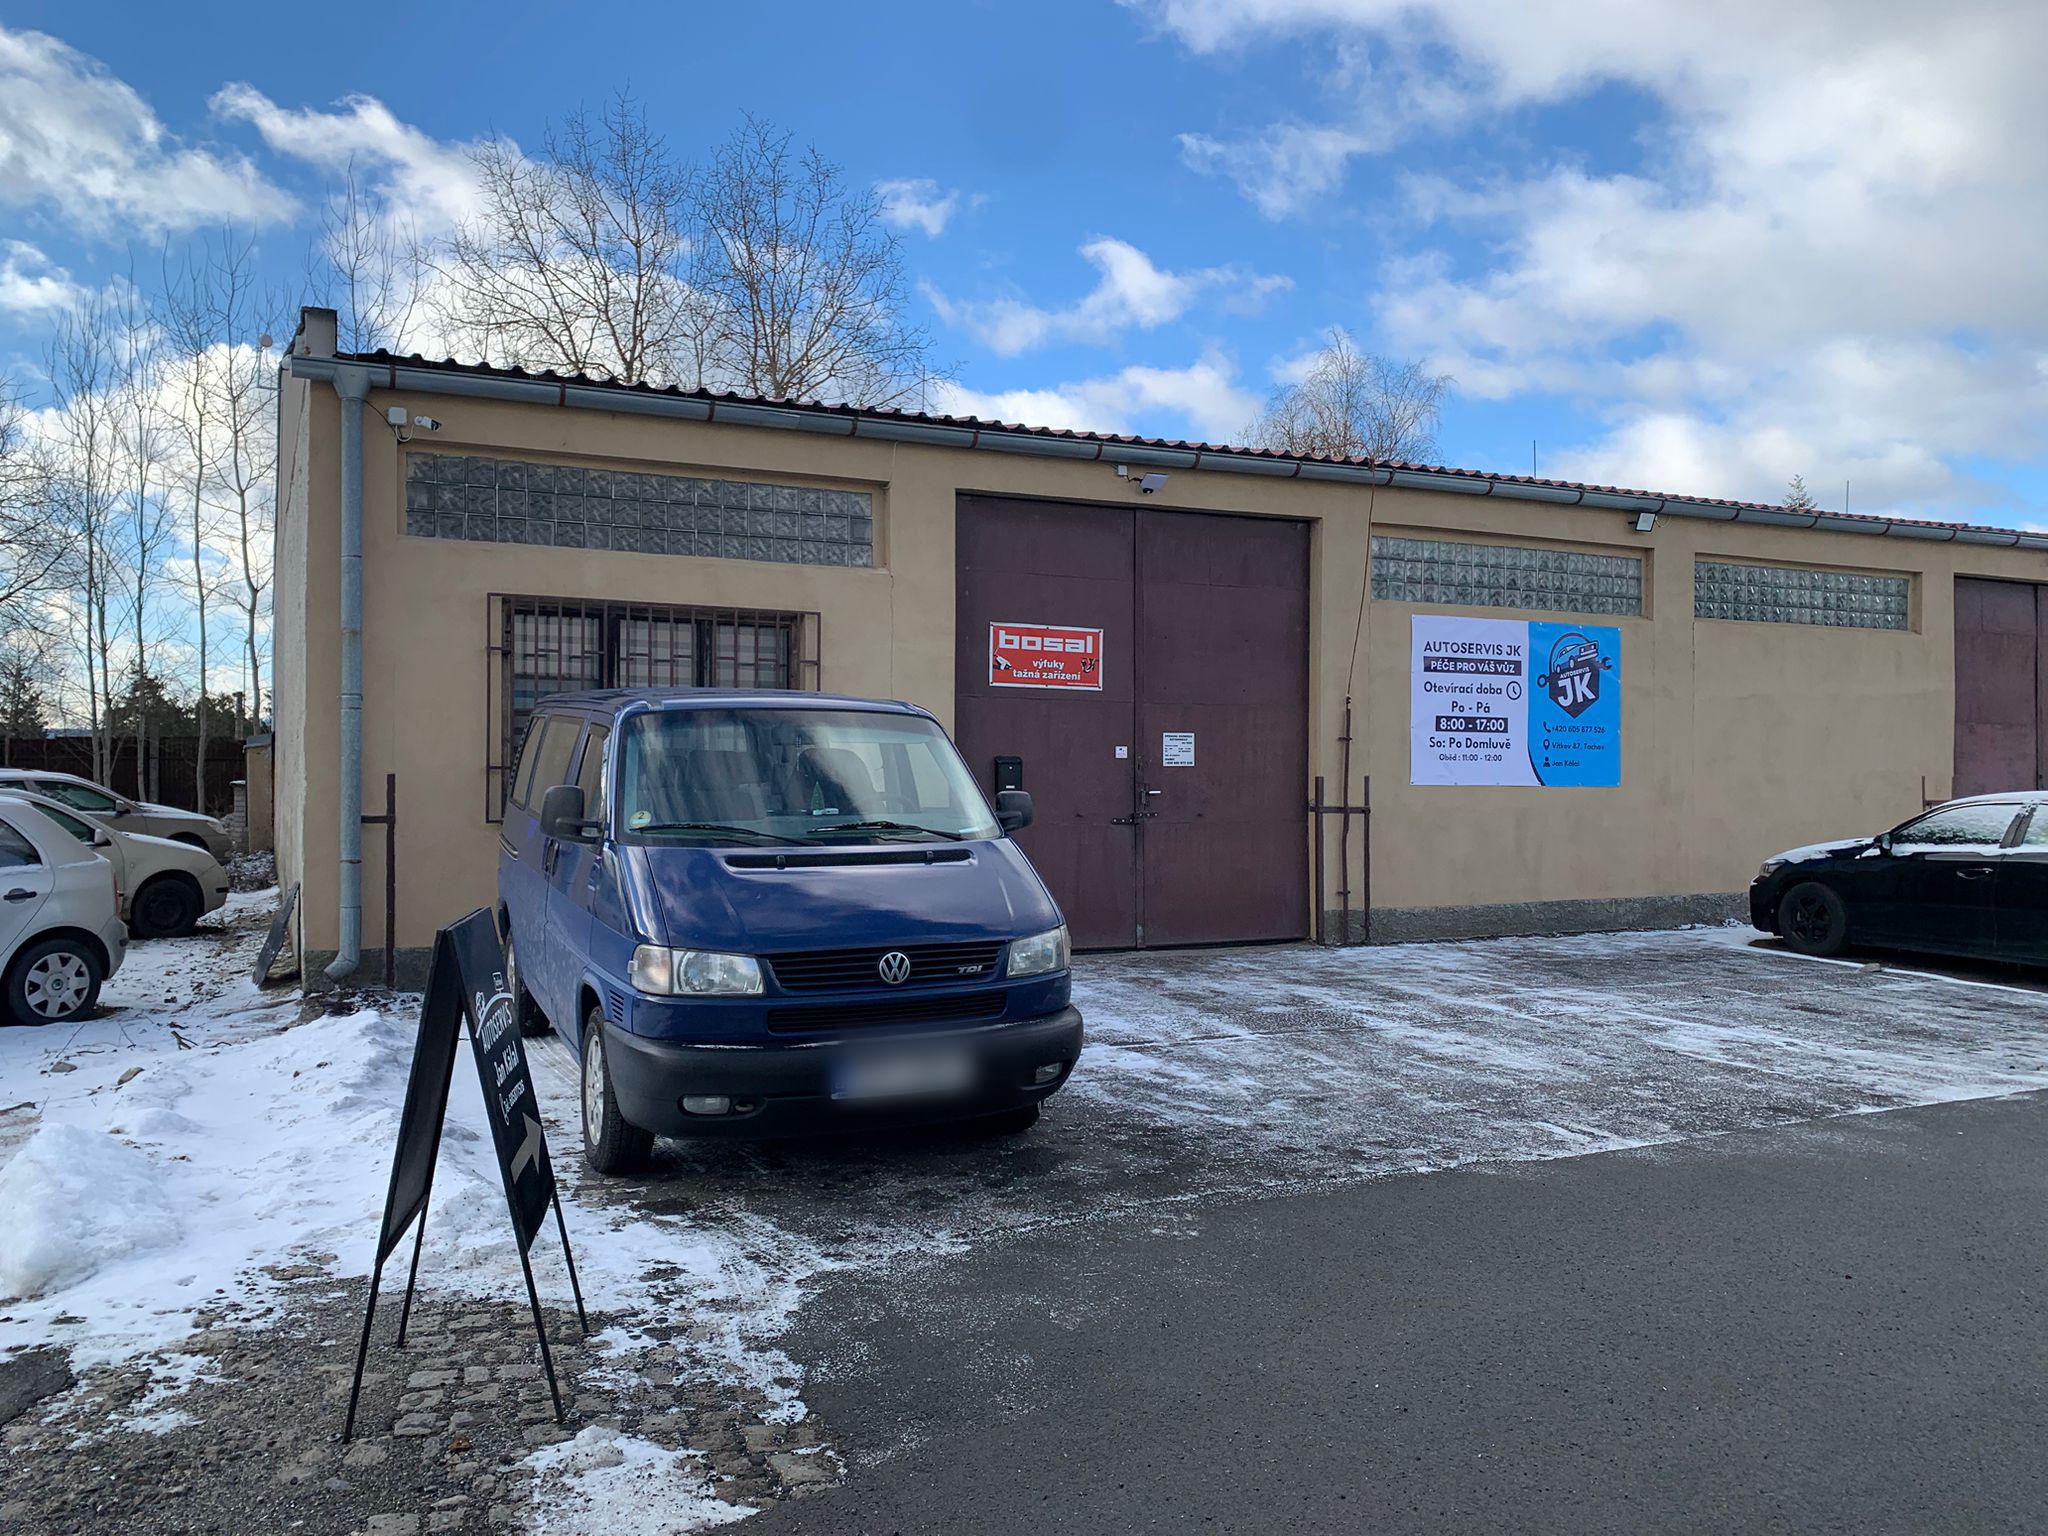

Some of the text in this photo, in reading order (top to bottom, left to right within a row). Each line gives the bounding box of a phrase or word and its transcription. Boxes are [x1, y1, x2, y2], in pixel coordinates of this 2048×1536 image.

[999, 630, 1093, 653] bosal
[1424, 641, 1521, 656] AUTOSERVIS JK
[1032, 658, 1065, 669] výfuky
[1431, 658, 1515, 674] PÉČE PRO VÁŠ VŮZ
[1013, 669, 1040, 678] tažná
[1560, 667, 1590, 679] AUTOSERVIS
[1424, 681, 1502, 695] Otevírací doba
[1558, 672, 1596, 707] JK
[1451, 701, 1465, 713] Po
[1476, 701, 1490, 713] Pá
[1440, 718, 1465, 730] 8:00
[1476, 719, 1504, 731] 17:00
[1429, 737, 1511, 750] So: Po Domluvě
[1484, 754, 1502, 762] 12:00
[957, 965, 982, 974] TDI
